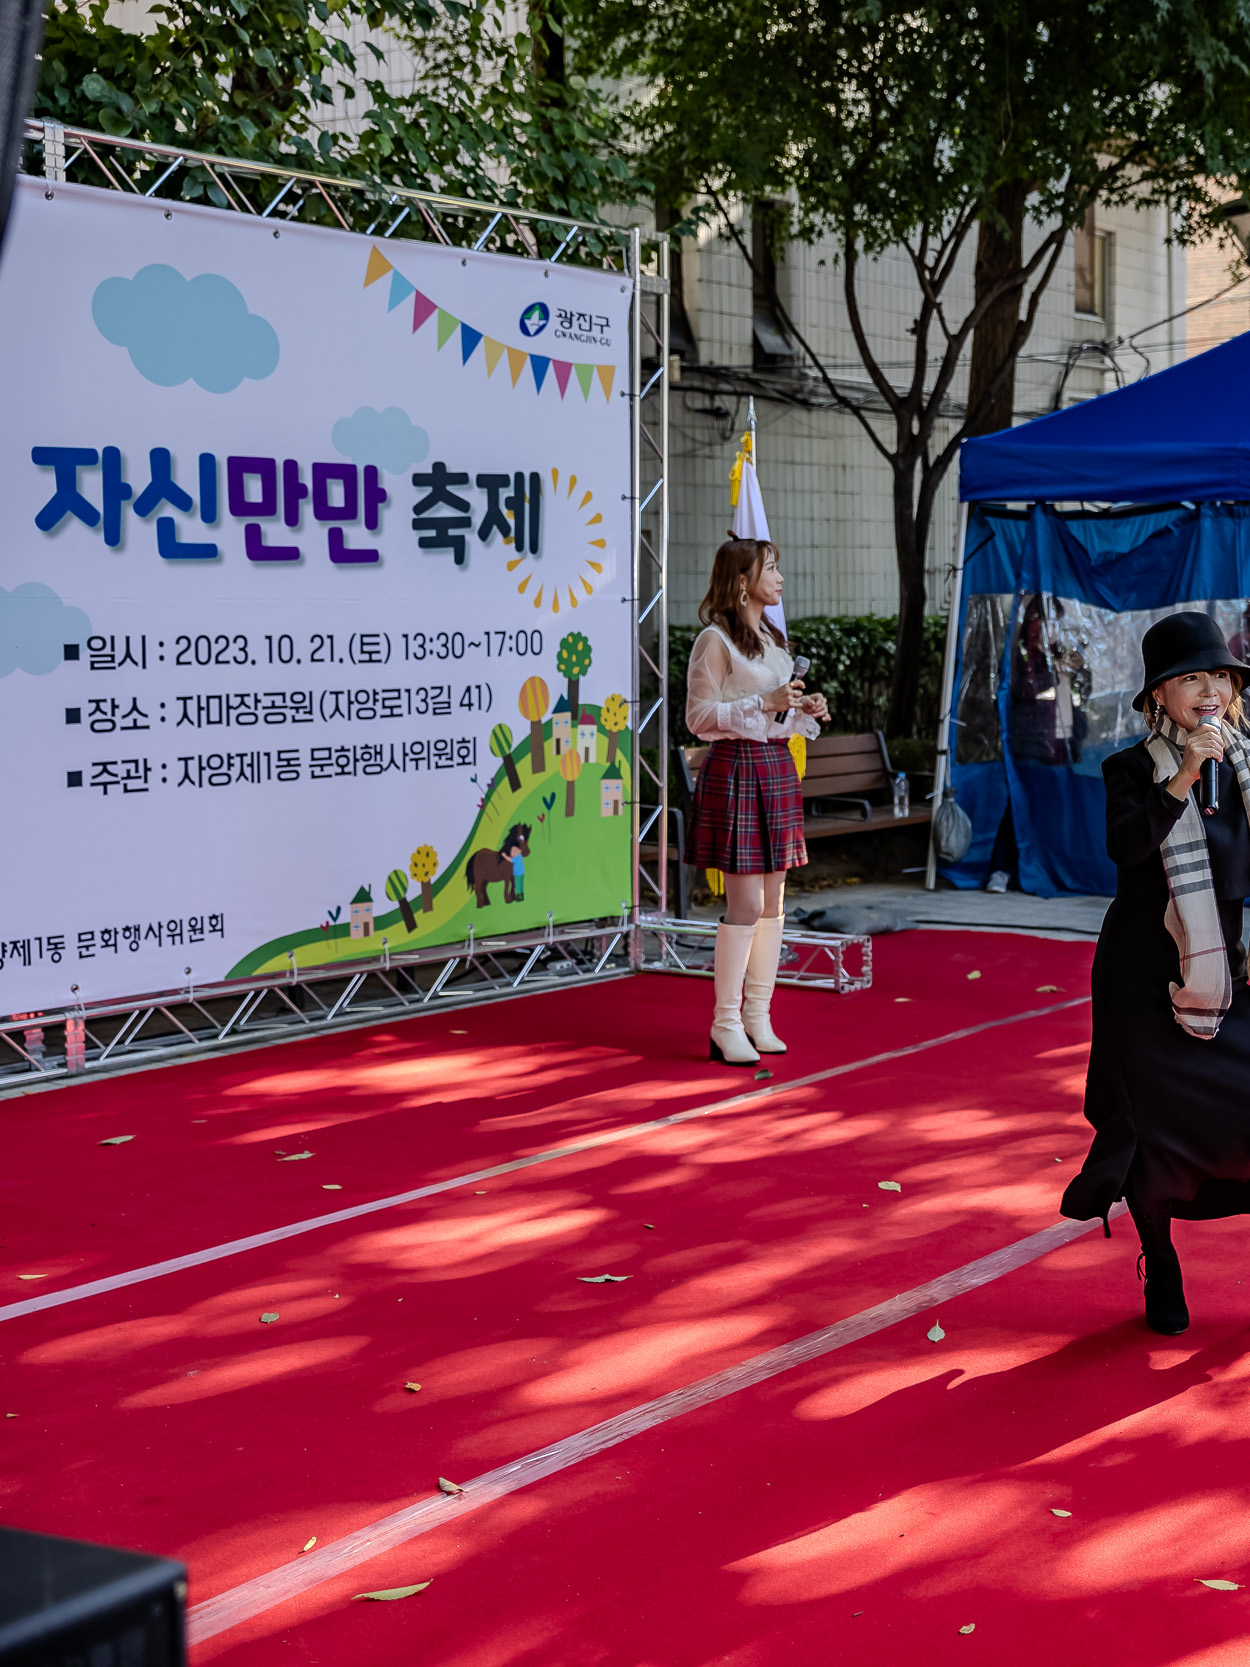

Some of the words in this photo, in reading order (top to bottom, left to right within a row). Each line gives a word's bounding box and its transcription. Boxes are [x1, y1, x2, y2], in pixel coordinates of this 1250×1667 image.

[554, 328, 612, 348] GWANGJIN-GU
[555, 308, 611, 335] 광진구
[31, 445, 388, 564] 자신만만
[411, 461, 541, 566] 축제
[87, 634, 147, 671] 일시
[175, 634, 257, 666] 2023.
[401, 629, 543, 661] 13:30~17:00
[87, 696, 151, 734] 장소
[89, 757, 152, 796] 주관
[177, 750, 302, 789] 자양제1동
[308, 736, 478, 780] 문화행사위원회
[77, 913, 225, 960] 문화행사위원회
